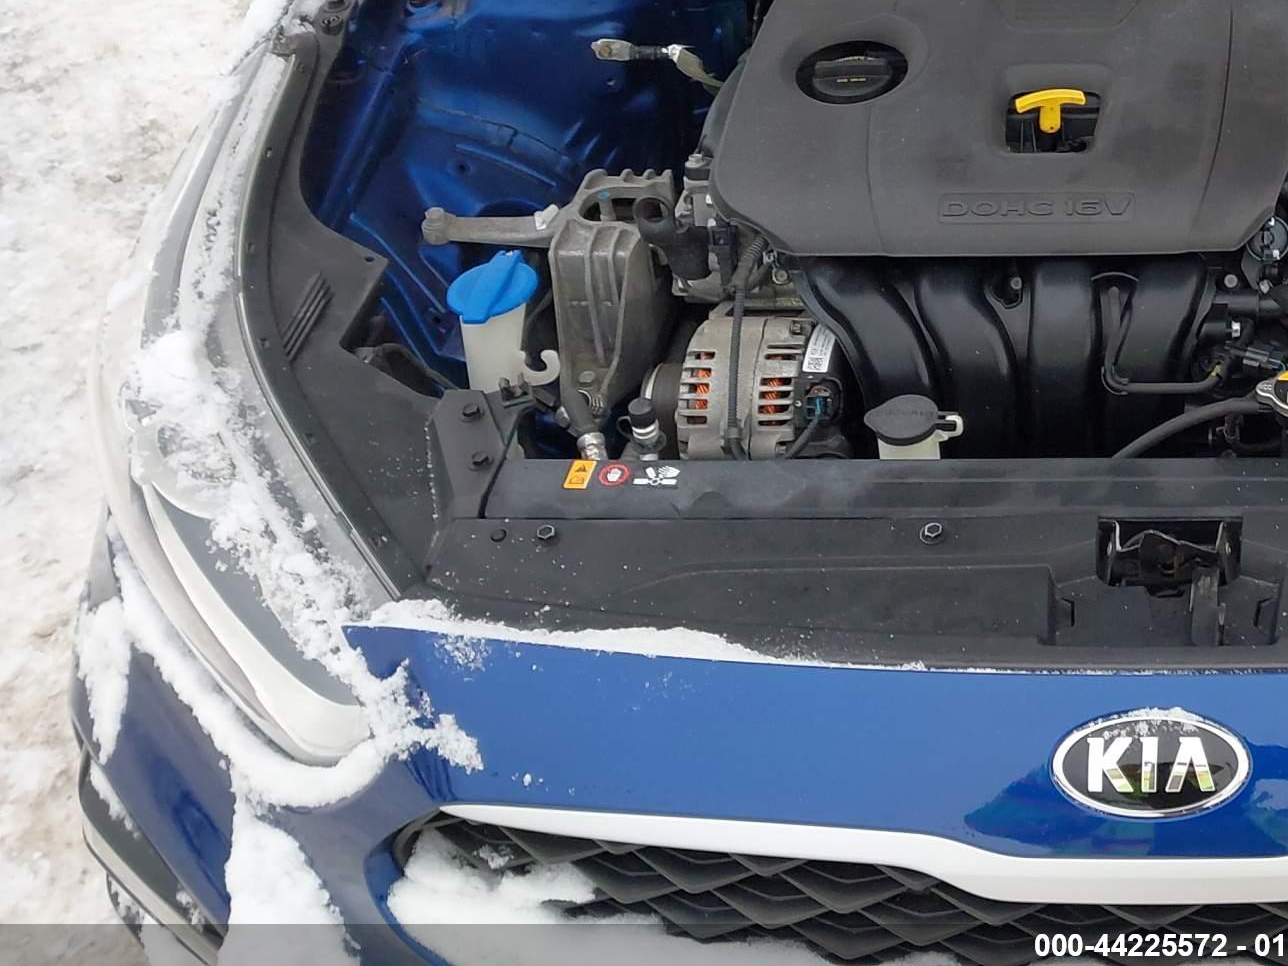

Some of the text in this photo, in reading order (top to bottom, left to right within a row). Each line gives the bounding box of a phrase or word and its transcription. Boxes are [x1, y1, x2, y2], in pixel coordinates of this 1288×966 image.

[942, 199, 1132, 217] DOHC 16V
[1087, 736, 1216, 793] KIA
